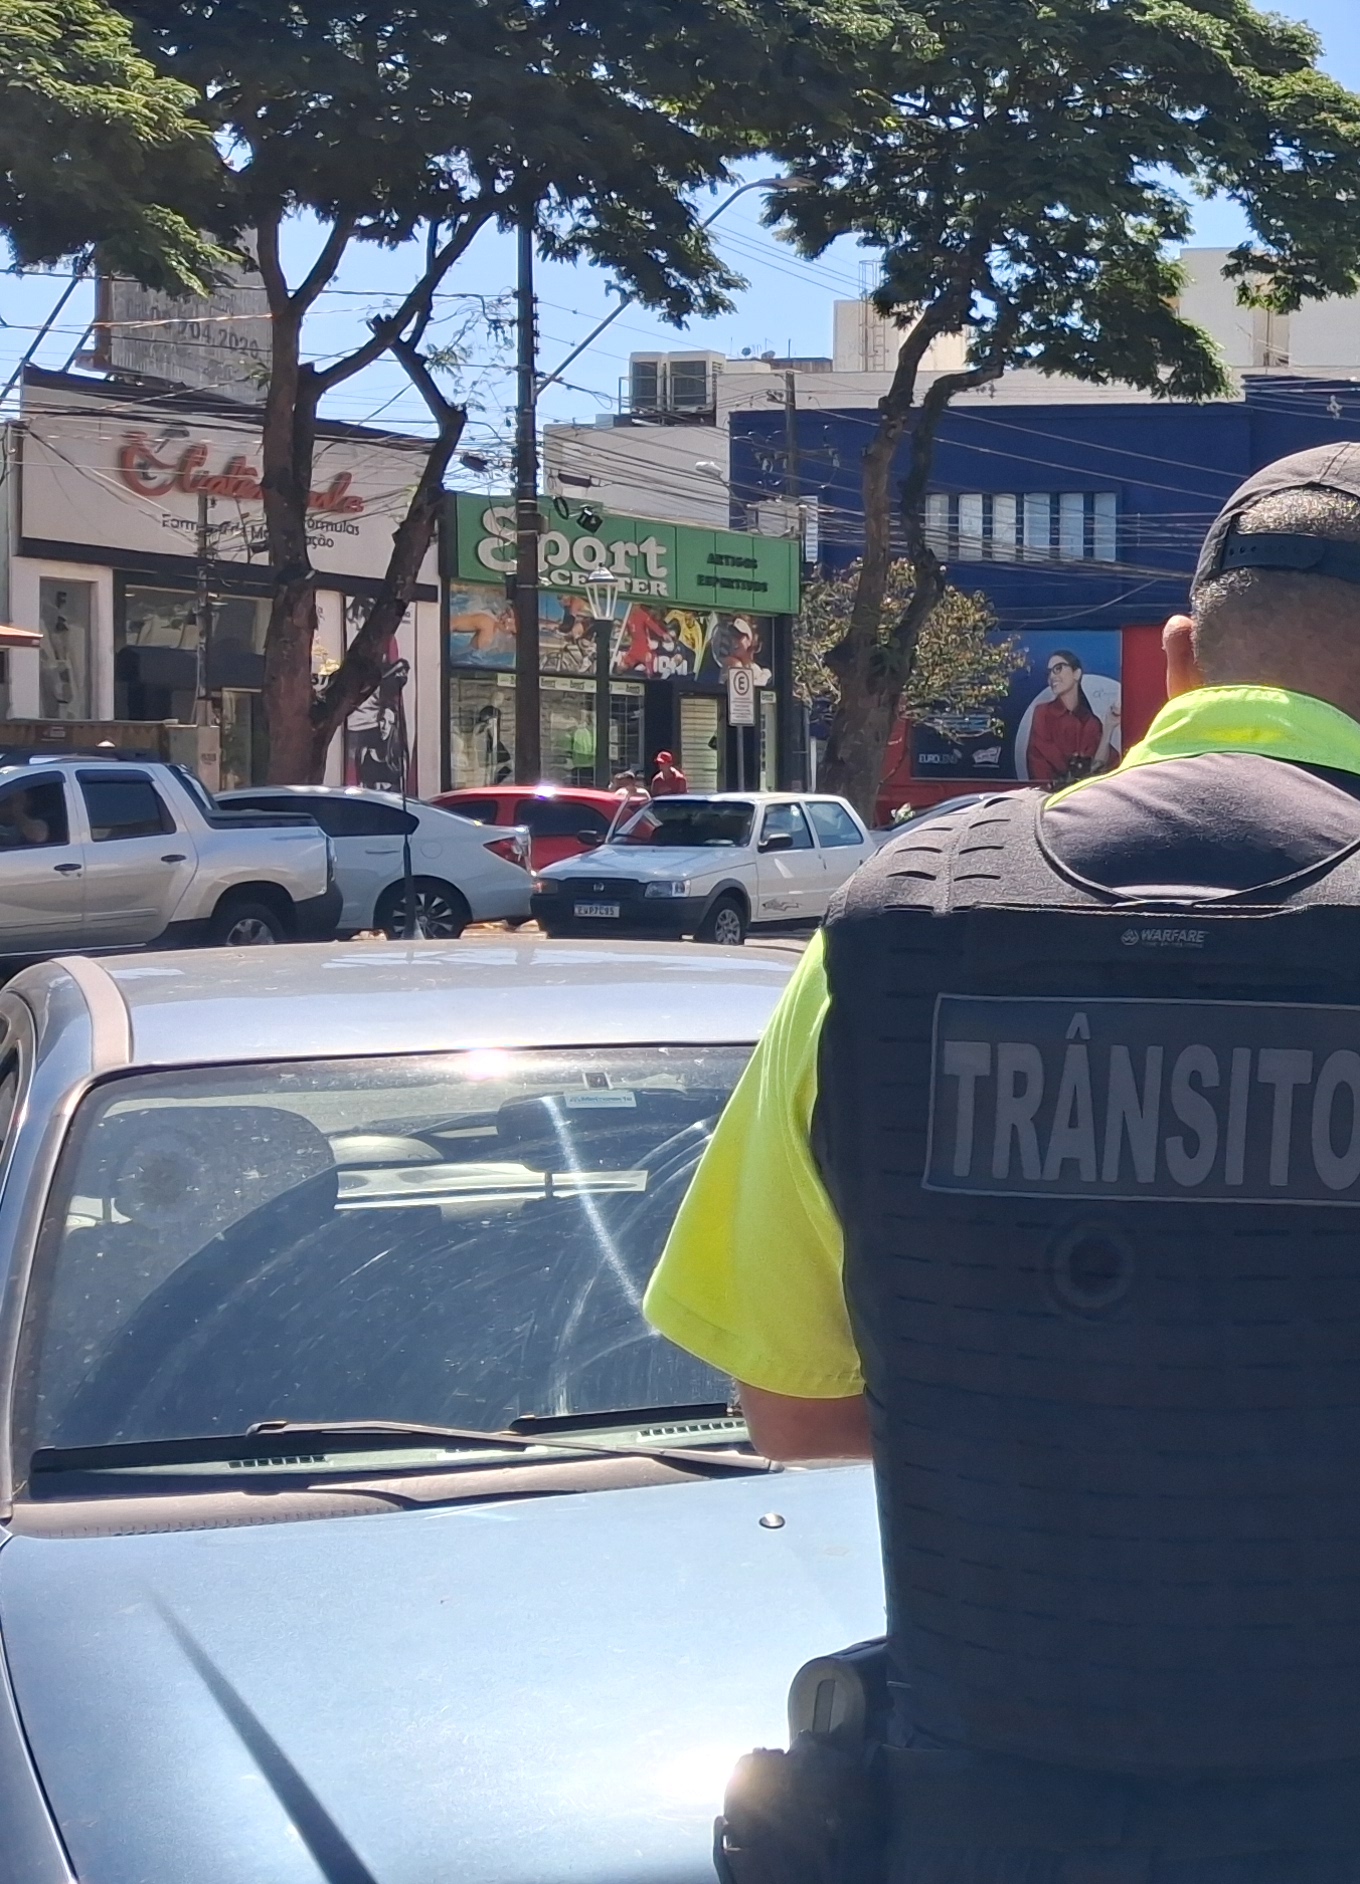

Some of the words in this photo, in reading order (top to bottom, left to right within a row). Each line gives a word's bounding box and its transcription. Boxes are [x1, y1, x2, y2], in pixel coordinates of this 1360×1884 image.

[303, 517, 360, 536] órmulas
[478, 505, 668, 578] Sport
[550, 568, 669, 597] CETER
[1141, 929, 1206, 943] WARFARE
